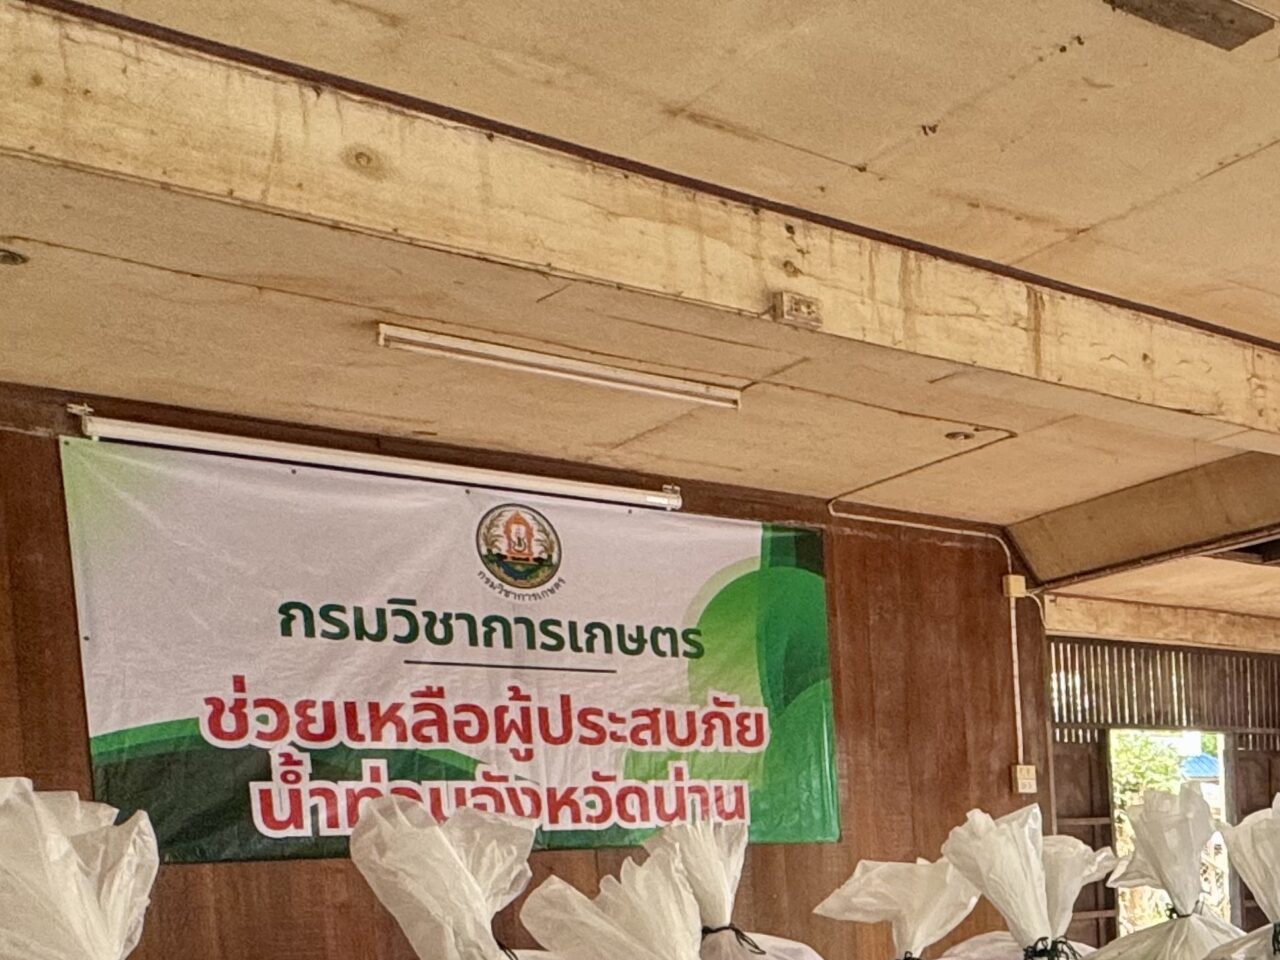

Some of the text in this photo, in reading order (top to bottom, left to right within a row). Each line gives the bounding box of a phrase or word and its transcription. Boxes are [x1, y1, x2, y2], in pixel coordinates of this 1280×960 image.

[277, 597, 705, 660] กรมวิชาการเกษตร
[204, 674, 766, 761] ช่วยเหลือผู้ประสบภัย
